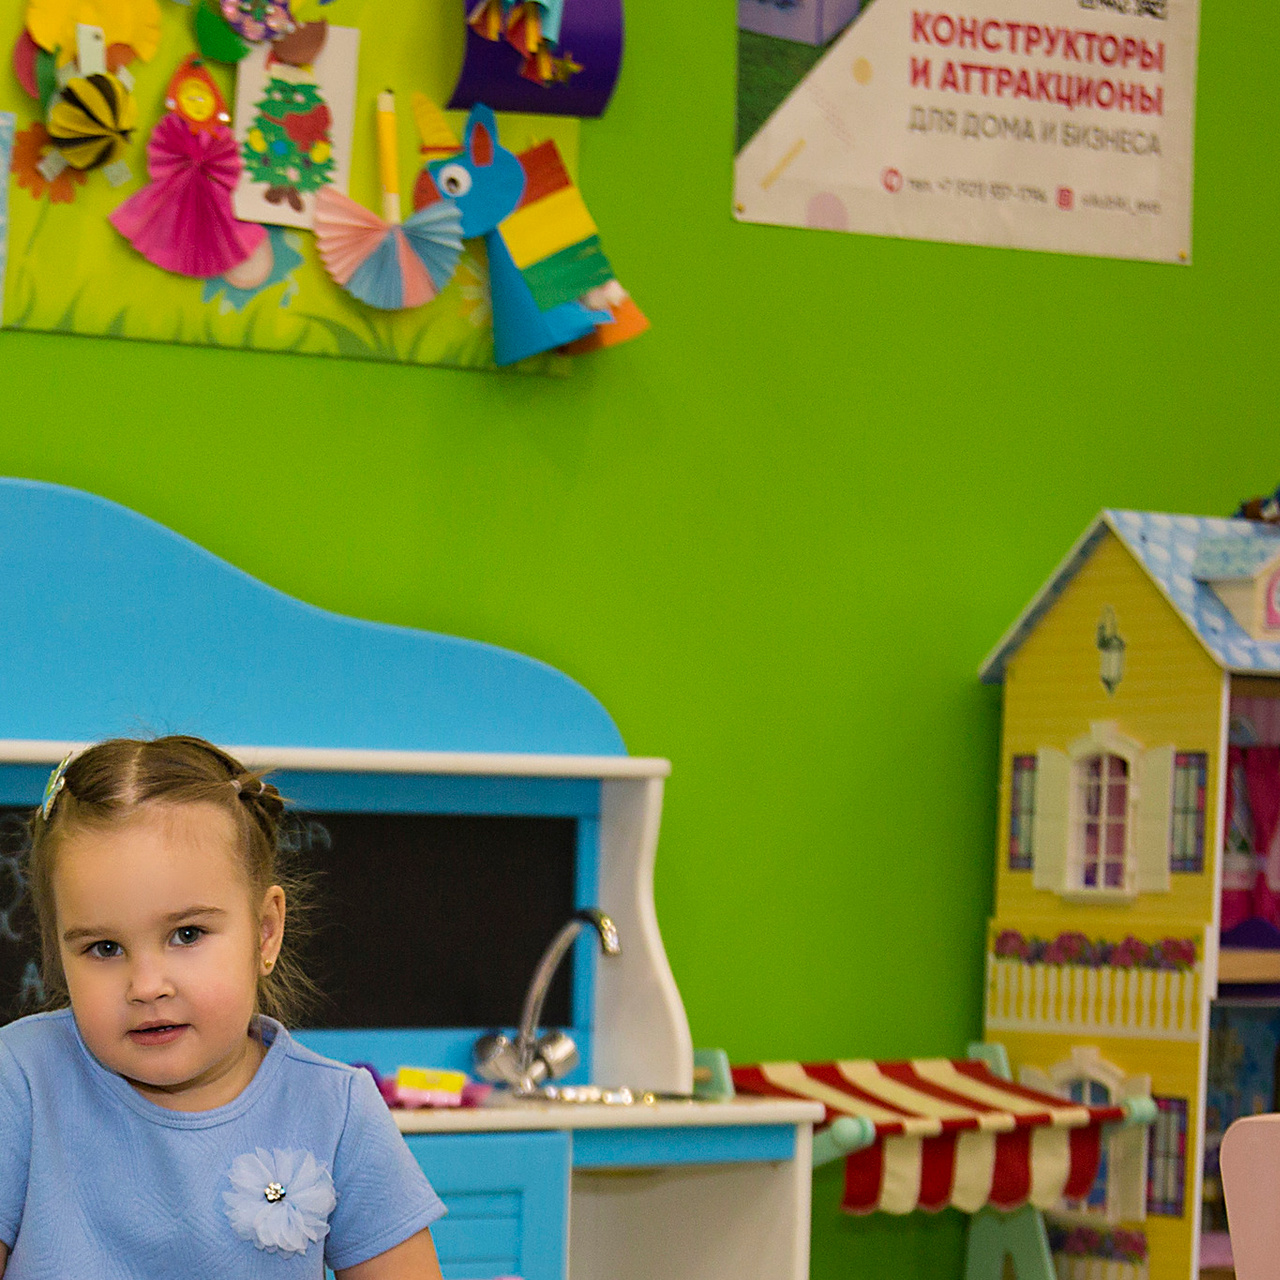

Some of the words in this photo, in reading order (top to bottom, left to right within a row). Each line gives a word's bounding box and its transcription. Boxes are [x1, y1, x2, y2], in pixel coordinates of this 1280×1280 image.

[910, 10, 1166, 73] КОНСТРУКТОРЫ
[909, 56, 932, 90] И
[939, 60, 1164, 116] АТТРАКЦИОНЫ
[908, 104, 958, 134] ДЛЯ
[961, 111, 1036, 142] ДОМА
[1040, 119, 1058, 144] И
[1061, 121, 1162, 156] БИЗНЕСА
